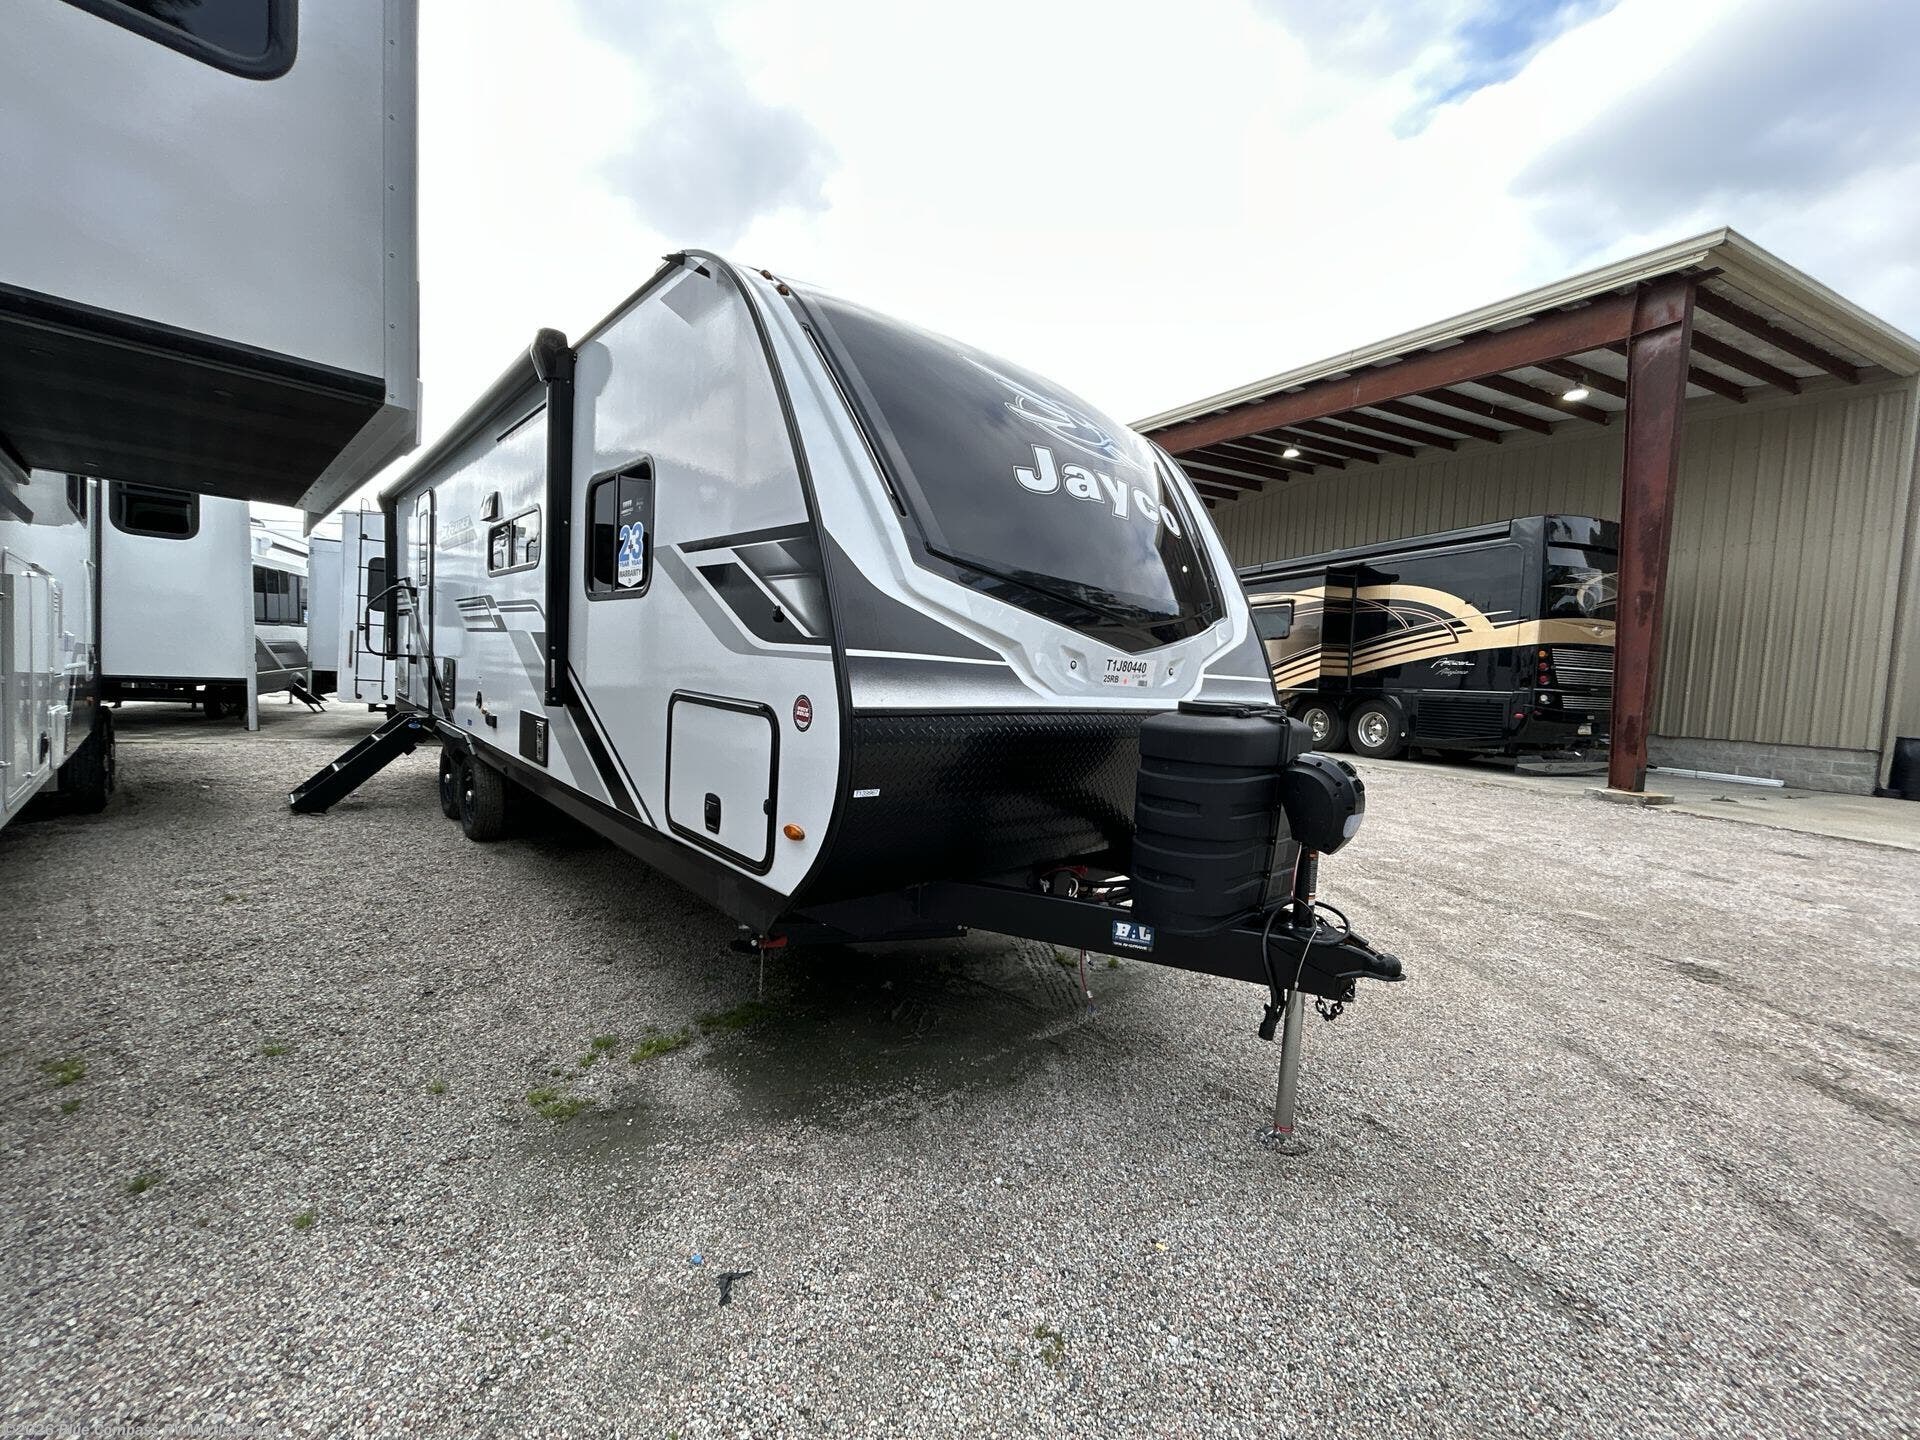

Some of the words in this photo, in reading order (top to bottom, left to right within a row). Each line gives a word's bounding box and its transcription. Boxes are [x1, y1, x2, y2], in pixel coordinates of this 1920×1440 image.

[1013, 444, 1181, 539] Jayco
[1106, 659, 1147, 674] T1J80440
[1103, 675, 1119, 683] 25RB
